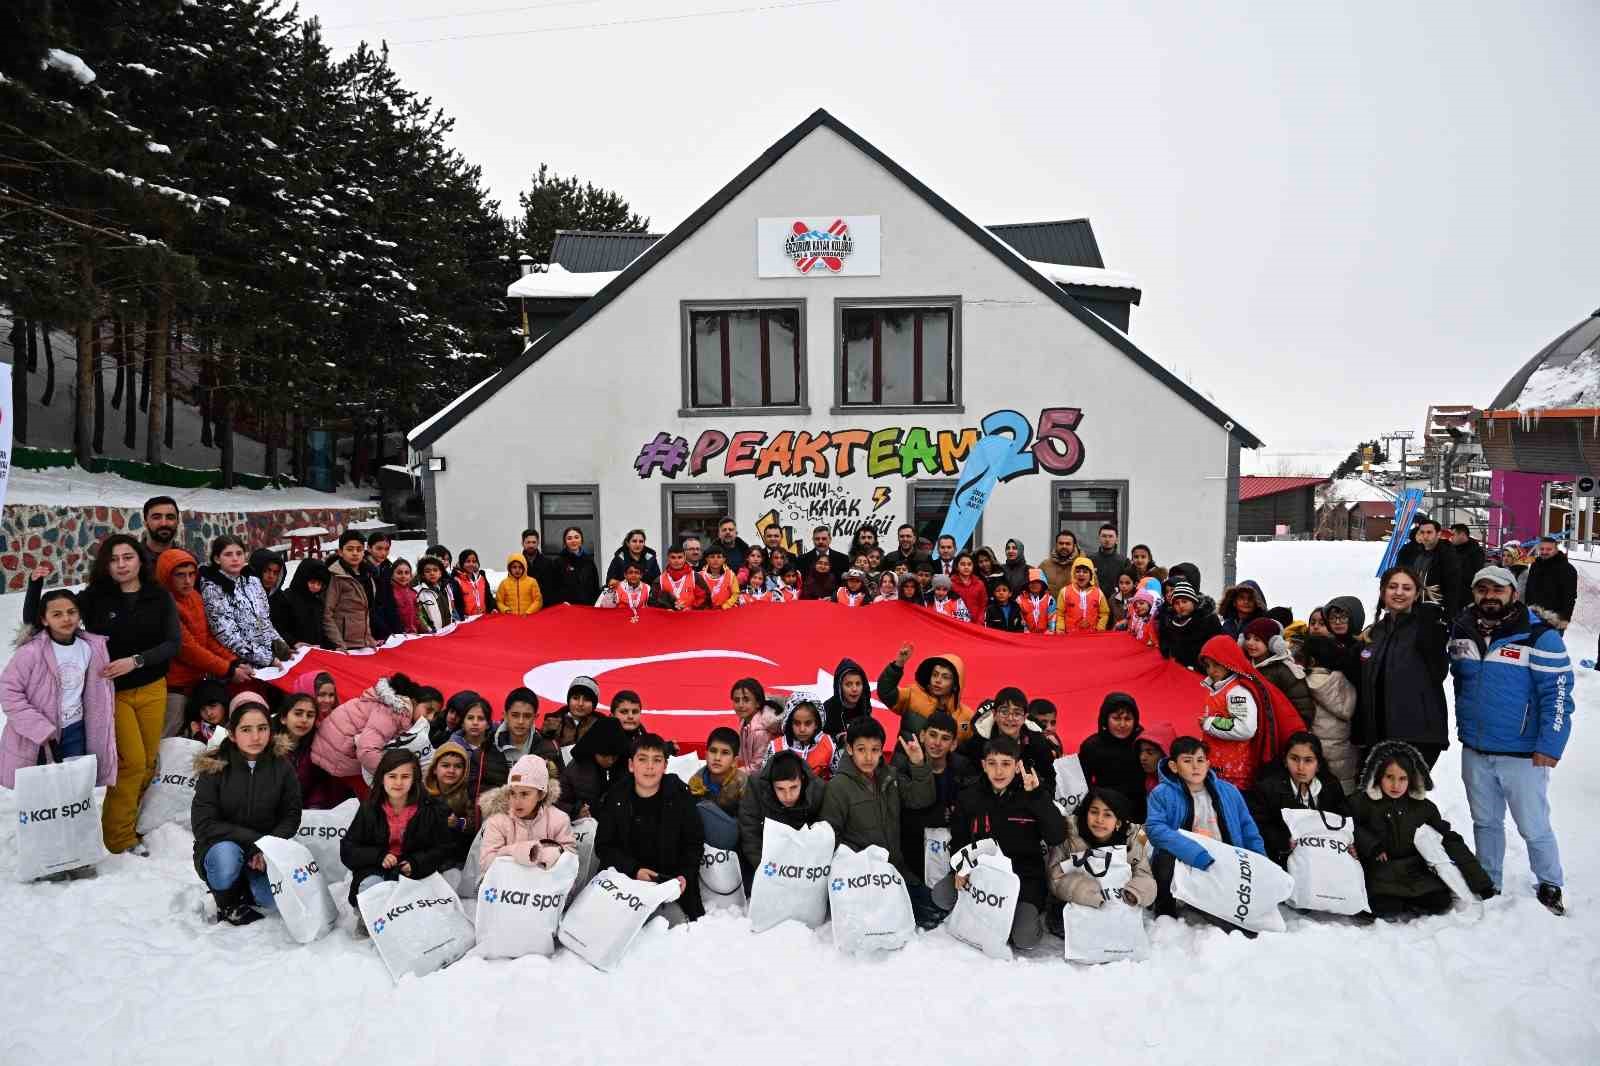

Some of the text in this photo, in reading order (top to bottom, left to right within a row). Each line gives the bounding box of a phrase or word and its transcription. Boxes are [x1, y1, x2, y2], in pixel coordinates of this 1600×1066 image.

[763, 481, 827, 501] ERZURUM
[808, 498, 861, 518] KAYAK
[416, 896, 453, 908] spor
[1234, 884, 1252, 923] spor
